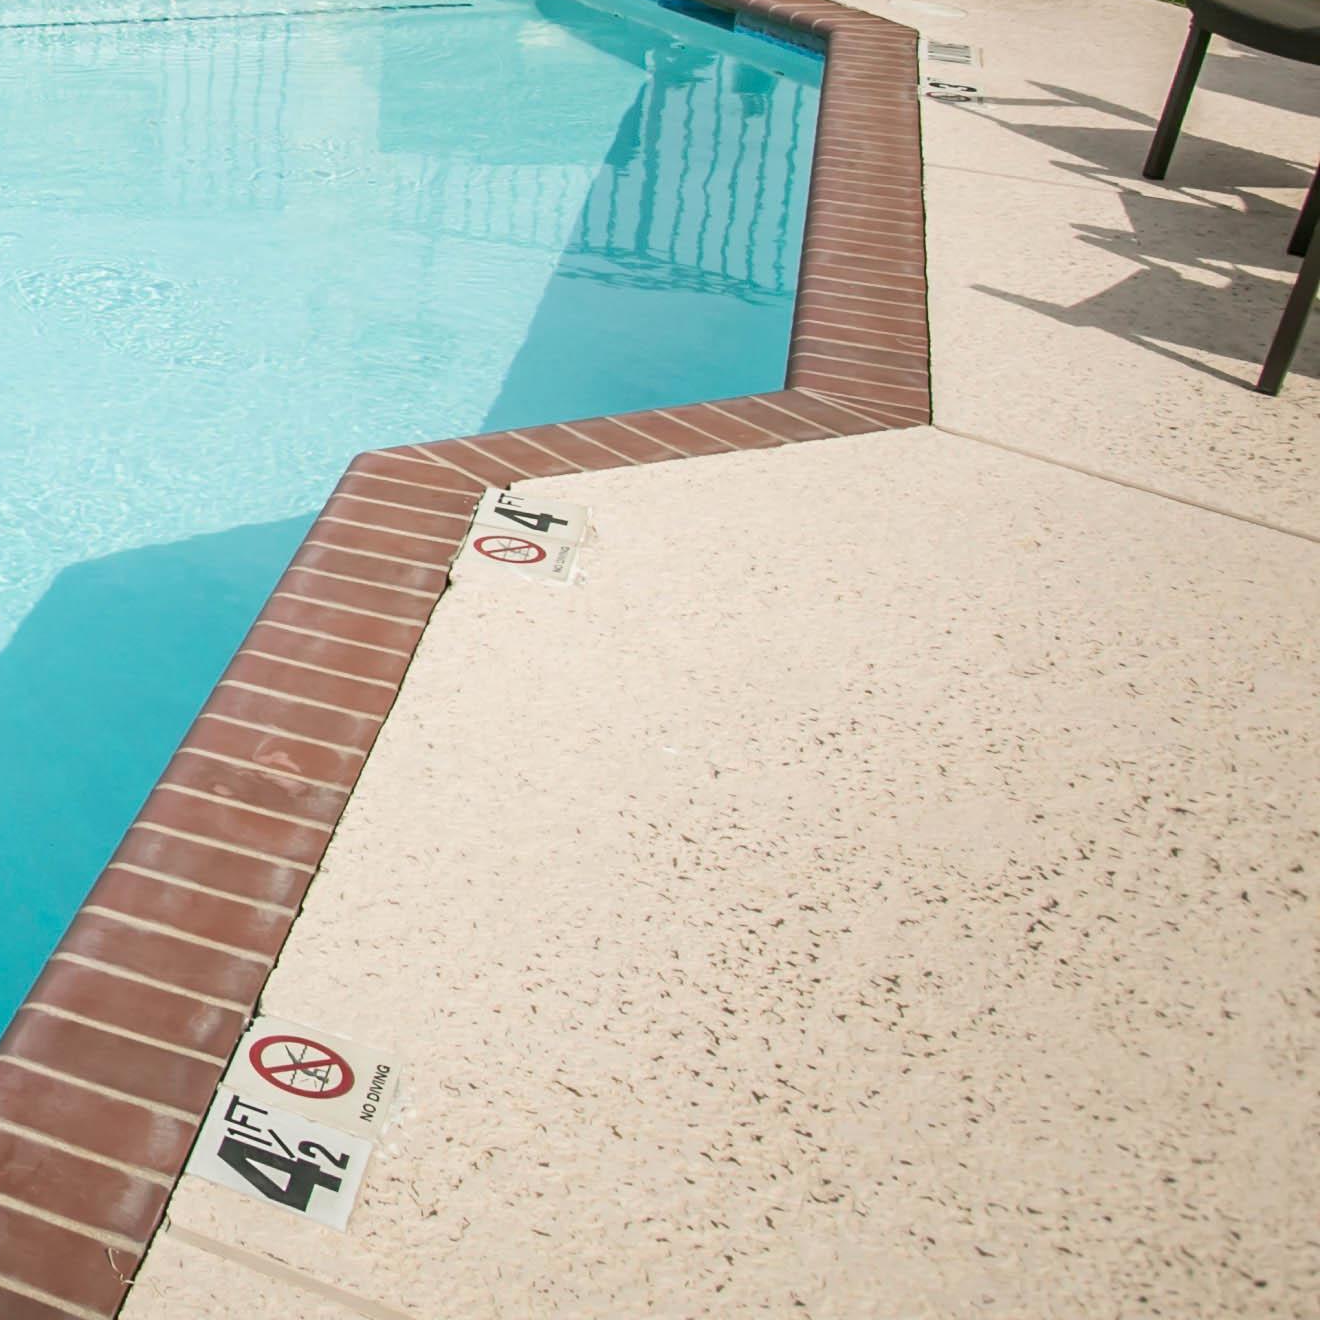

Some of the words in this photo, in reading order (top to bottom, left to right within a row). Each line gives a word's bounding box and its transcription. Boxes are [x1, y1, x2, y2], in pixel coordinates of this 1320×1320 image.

[497, 493, 525, 508] FT
[494, 506, 568, 533] 4
[367, 1064, 391, 1102] DIVING
[359, 1103, 376, 1123] NO
[216, 1135, 342, 1213] 4
